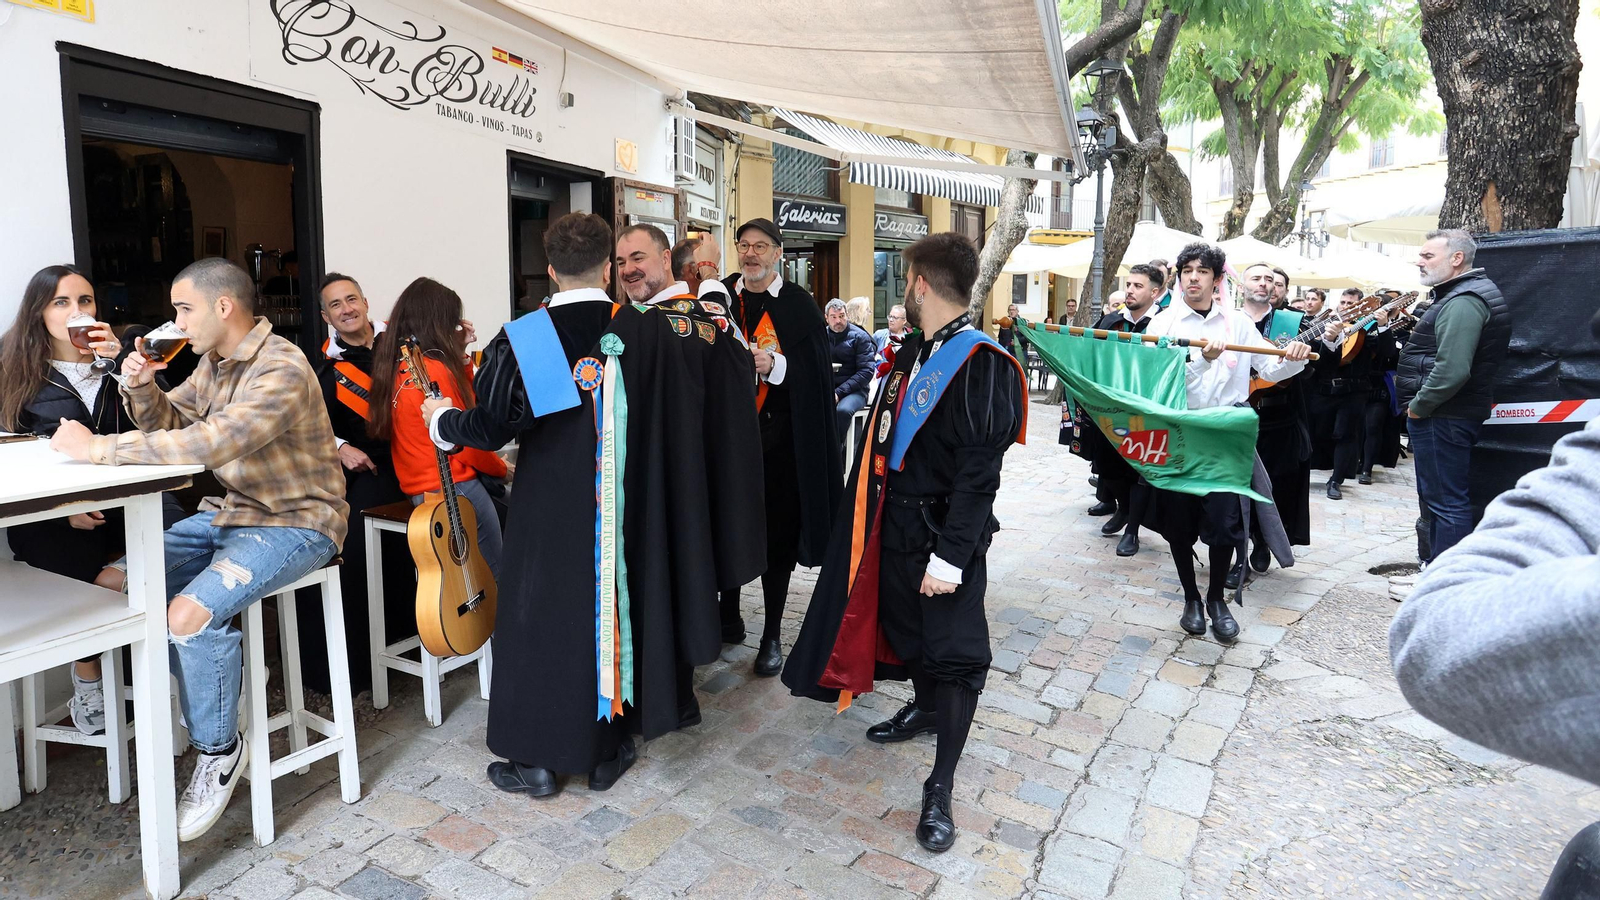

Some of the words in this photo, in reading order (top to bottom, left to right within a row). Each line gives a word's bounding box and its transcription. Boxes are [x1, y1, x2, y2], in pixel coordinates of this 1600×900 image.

[436, 103, 474, 124] TABANCO
[481, 115, 505, 132] VINOS
[511, 124, 533, 140] TAPAS
[778, 201, 842, 227] Galerias
[875, 213, 928, 237] Ragaza
[1495, 408, 1536, 418] BOMBEROS
[604, 430, 613, 459] XXXIV
[603, 461, 614, 513] CERTAMEN
[603, 515, 613, 528] DE
[603, 531, 613, 560] TUNAS
[602, 605, 612, 617] DE
[602, 650, 612, 667] 2023
